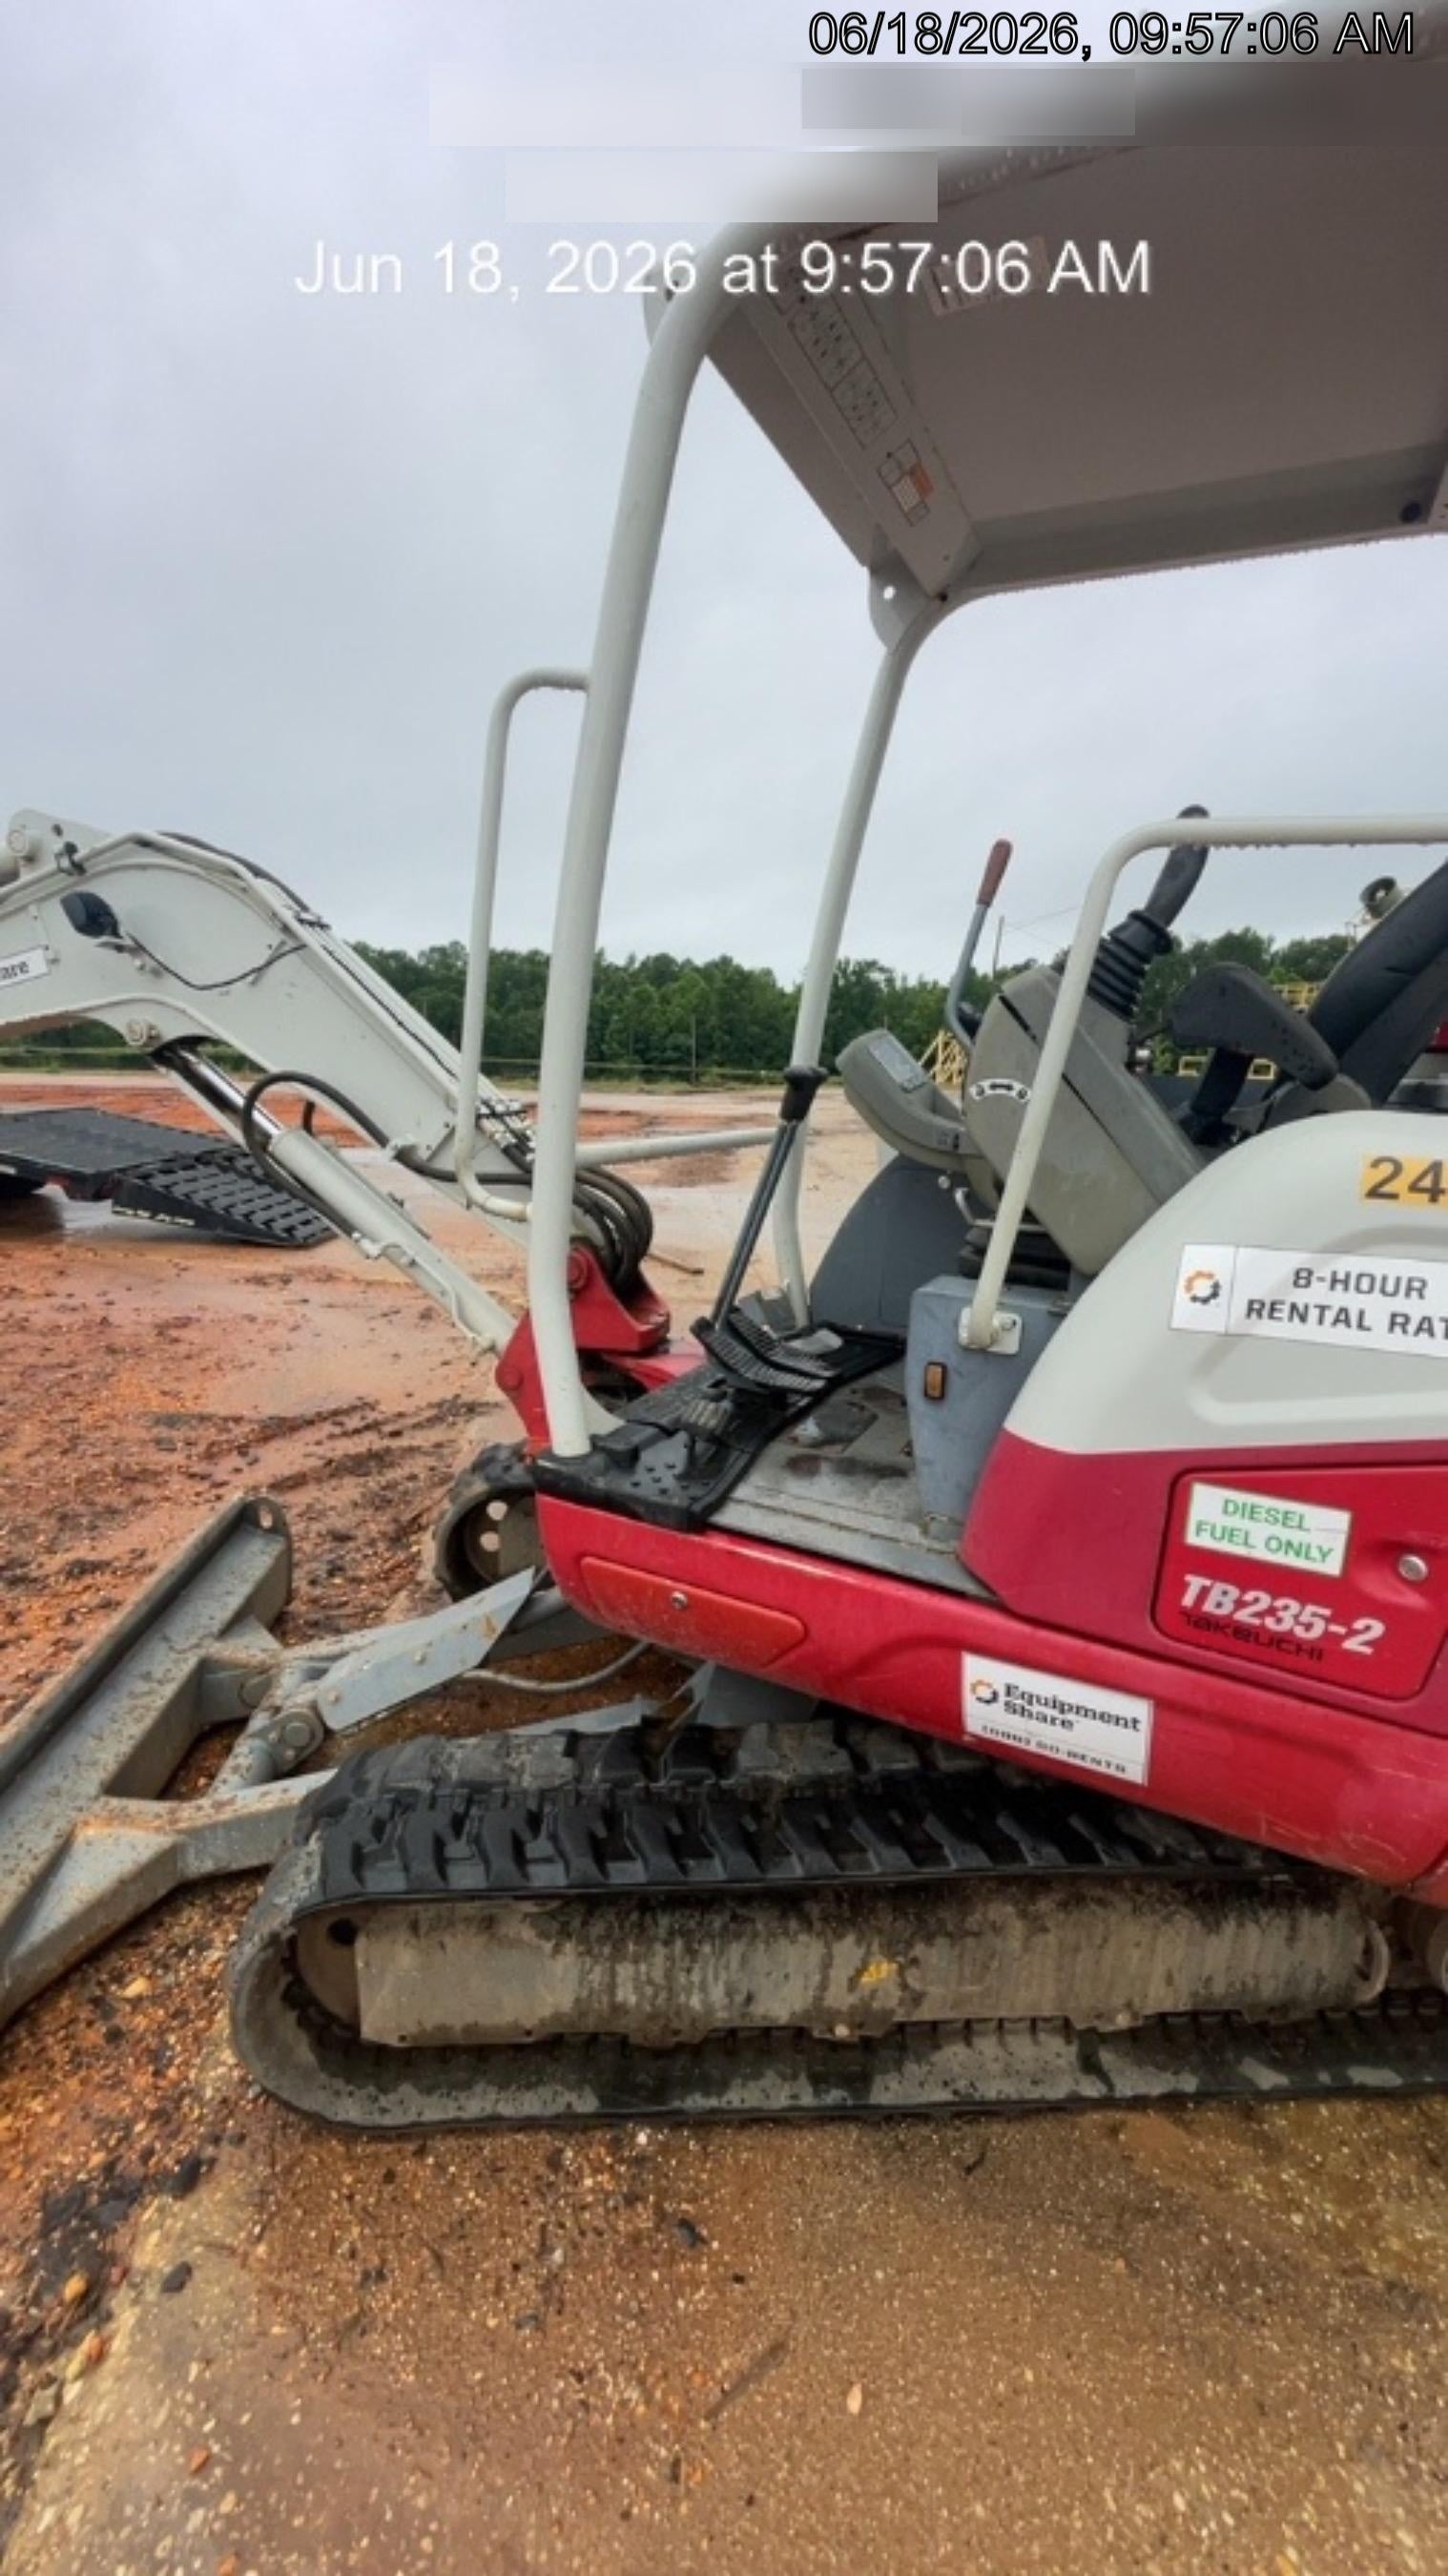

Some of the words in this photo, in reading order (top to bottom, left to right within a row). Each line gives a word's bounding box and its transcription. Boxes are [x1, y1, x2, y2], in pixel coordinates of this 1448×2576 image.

[1293, 1267, 1429, 1300] 8-HOUR
[1245, 1298, 1374, 1332] RENTAL
[1221, 1498, 1311, 1532] DIESEL
[1195, 1520, 1256, 1548] FUEL
[1264, 1535, 1334, 1564] ONLY
[1180, 1574, 1386, 1655] TB235-2
[1003, 1683, 1142, 1733] Equipment
[1003, 1699, 1075, 1733] Share
